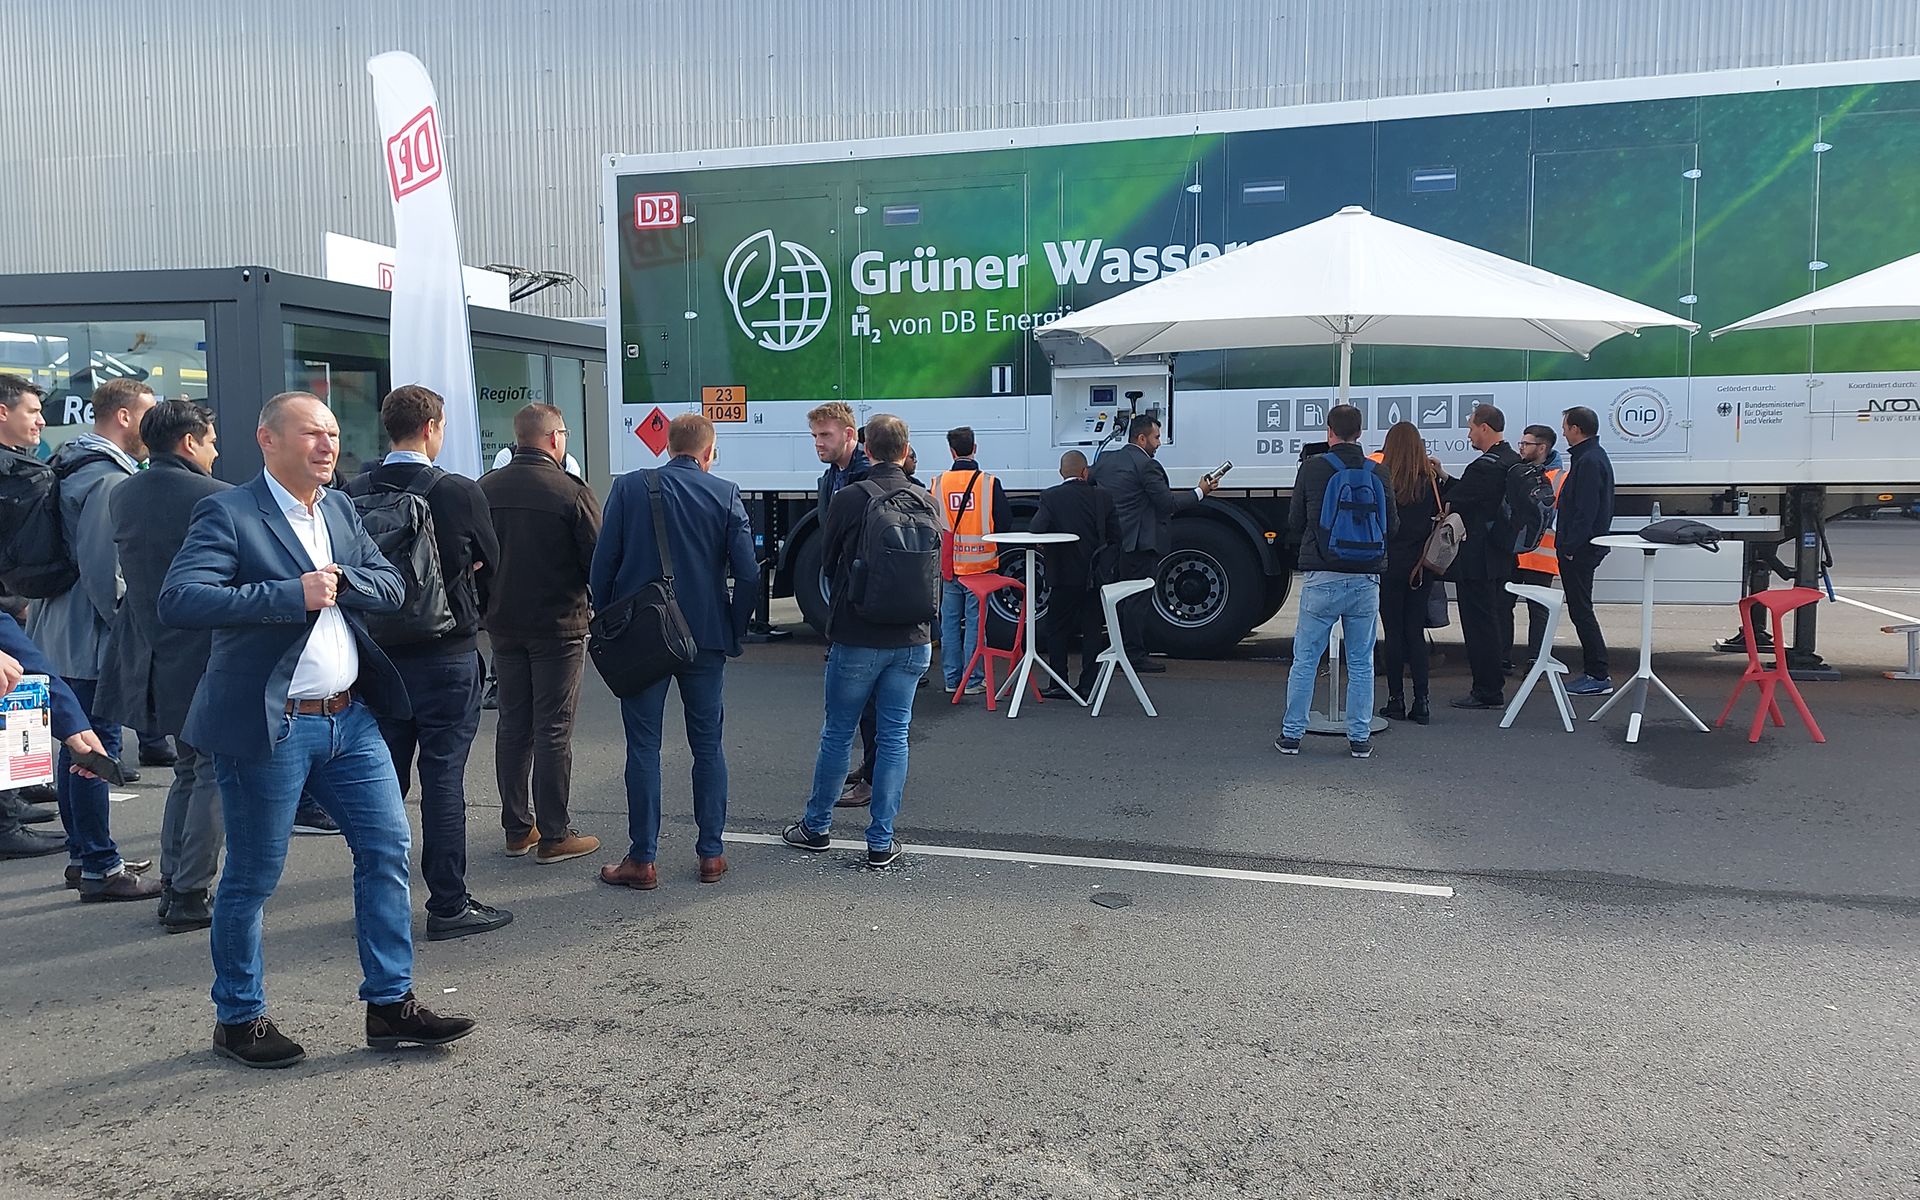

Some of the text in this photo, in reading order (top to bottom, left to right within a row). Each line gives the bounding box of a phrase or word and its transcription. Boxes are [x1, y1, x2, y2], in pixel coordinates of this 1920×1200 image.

[641, 199, 674, 223] DB
[851, 247, 1028, 295] Grüner
[888, 317, 932, 335] von
[941, 310, 976, 334] DB
[986, 305, 1077, 331] Energi
[480, 385, 543, 404] RegioTec
[716, 388, 733, 402] 23
[1717, 384, 1776, 393] Gefördert durch:
[63, 395, 96, 426] Re
[708, 406, 742, 420] 1049
[1744, 401, 1805, 409] Bundesministerium
[1625, 405, 1657, 425] nip
[1755, 410, 1783, 418] Digitales
[1257, 439, 1284, 454] DB
